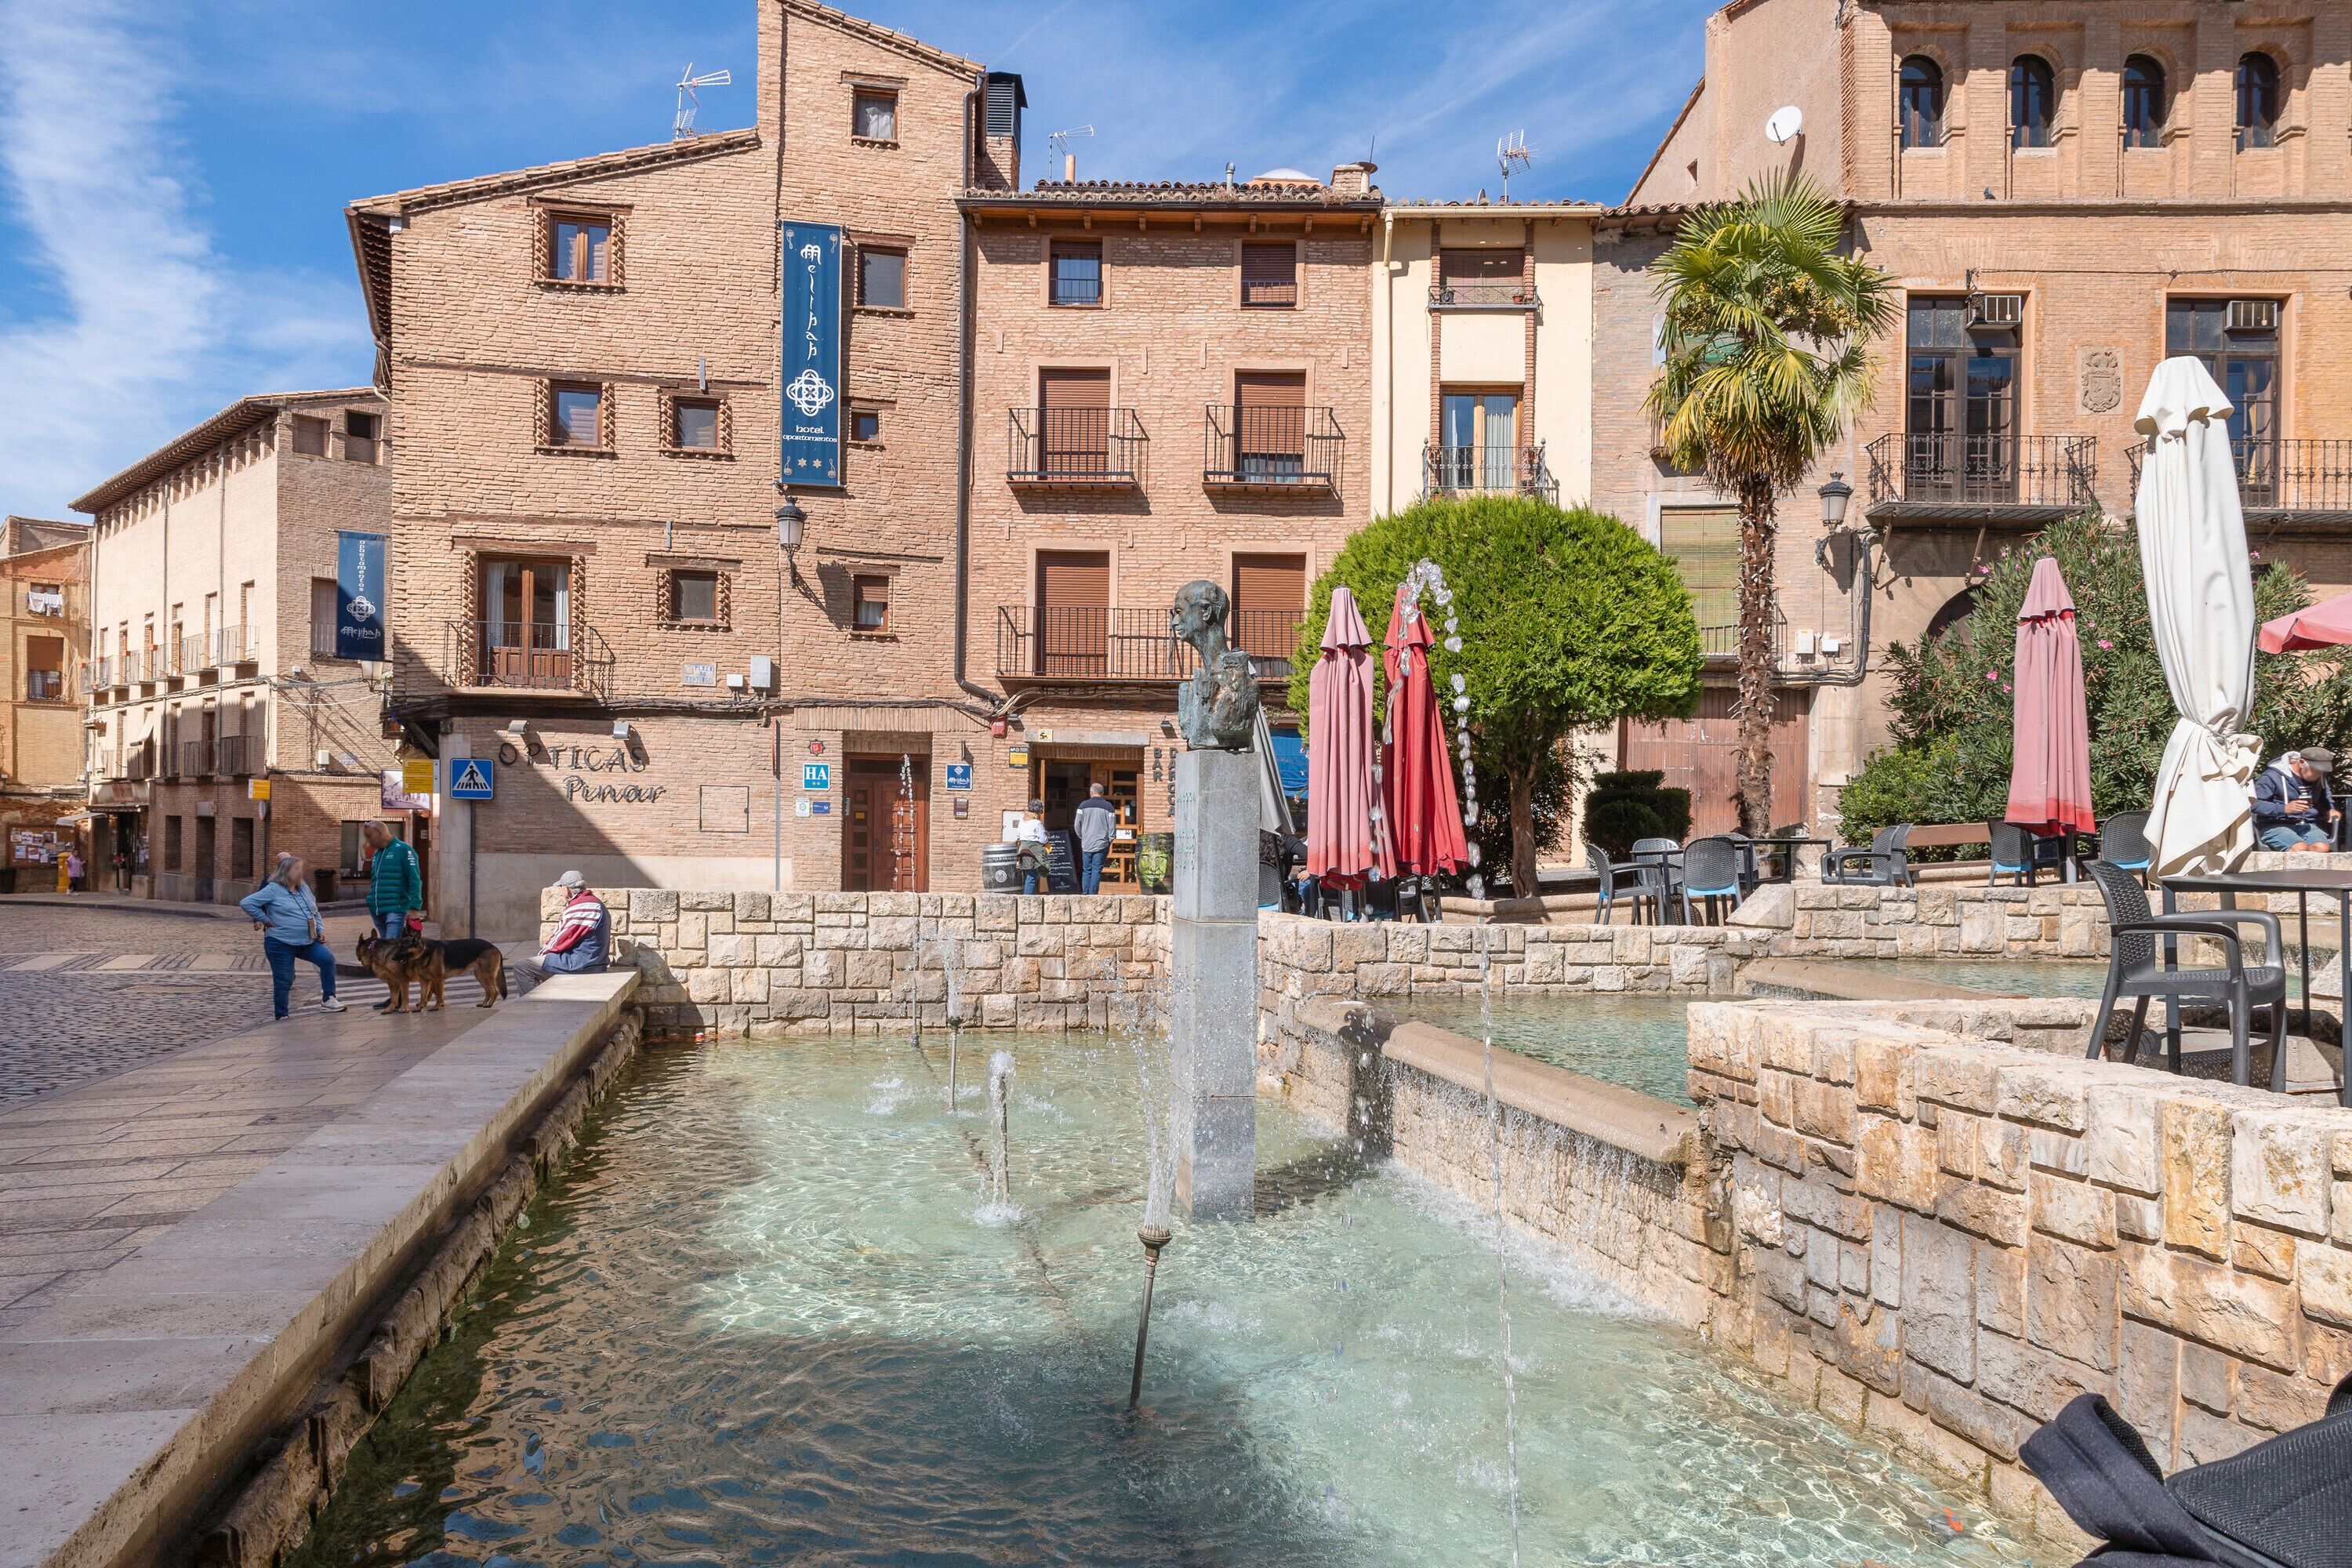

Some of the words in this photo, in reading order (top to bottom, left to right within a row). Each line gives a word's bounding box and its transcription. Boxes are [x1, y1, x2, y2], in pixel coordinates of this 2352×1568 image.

[782, 434, 837, 443] apartamentos
[796, 425, 825, 434] hotel
[357, 540, 366, 592] apartamentos
[499, 742, 645, 772] OPTICAS
[1152, 747, 1163, 782] BAR
[805, 766, 828, 780] HA
